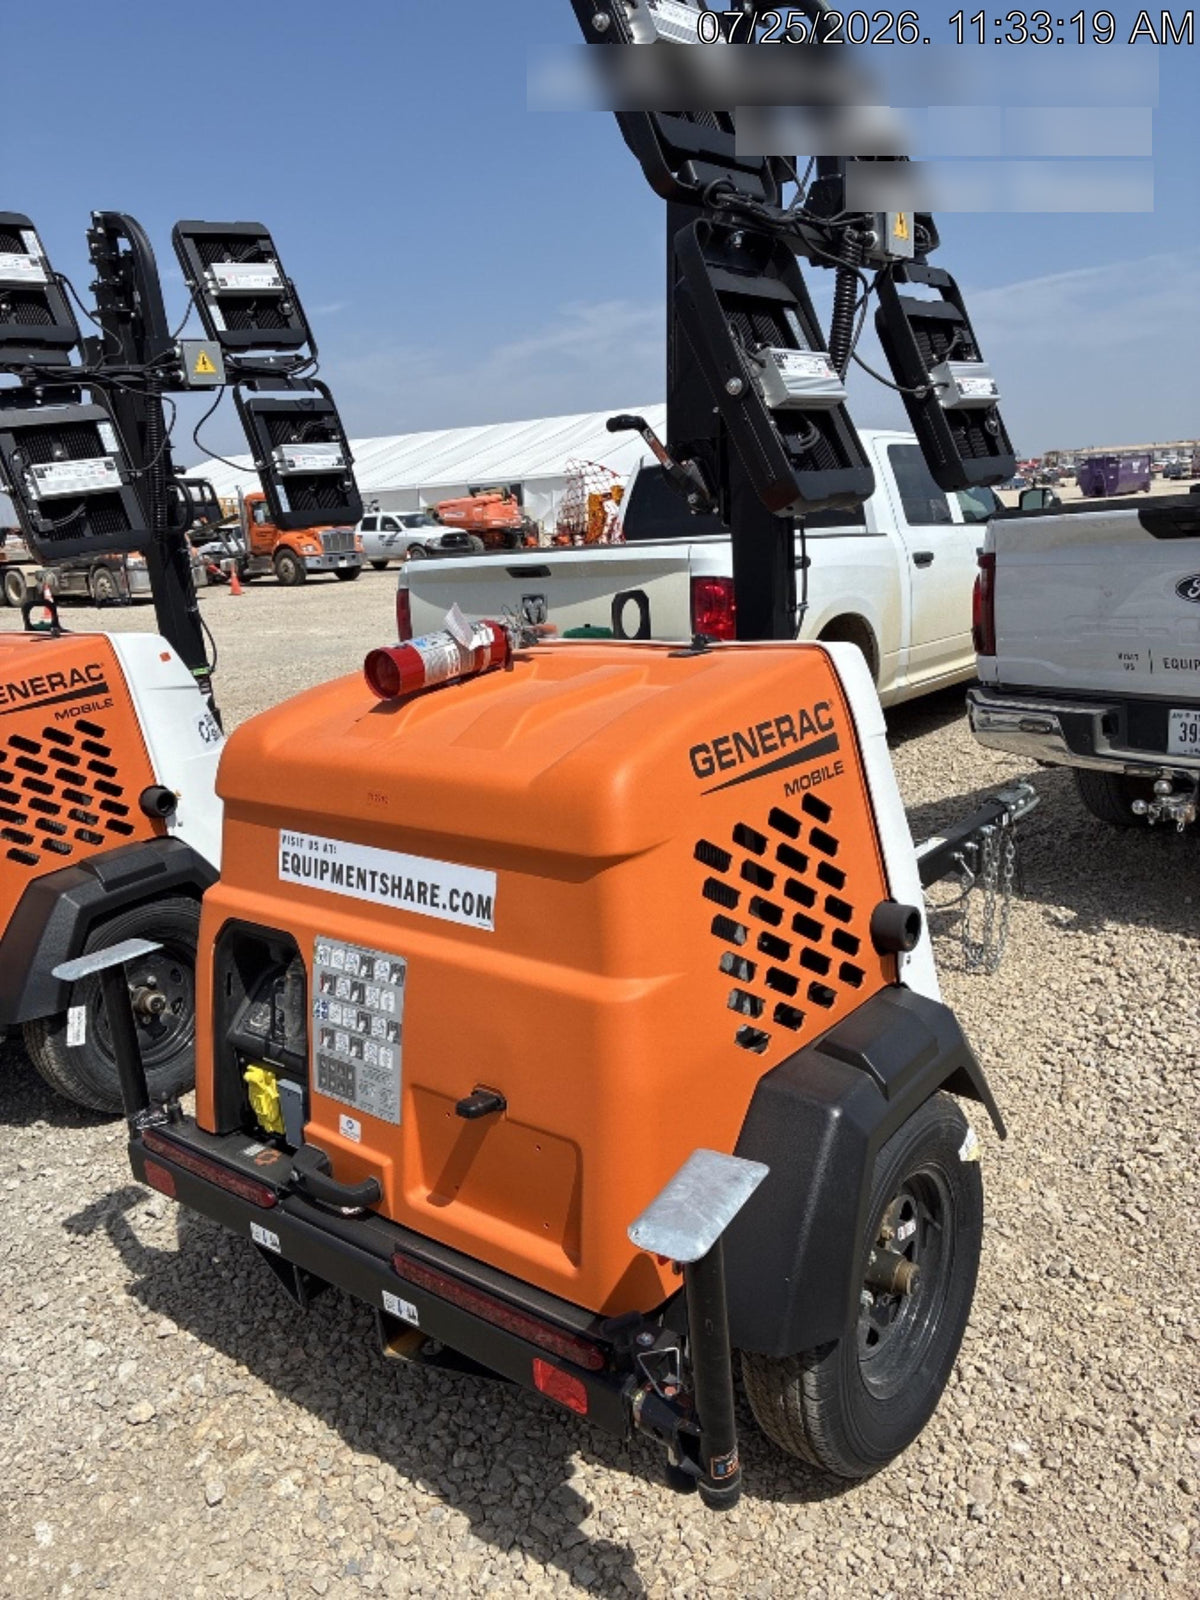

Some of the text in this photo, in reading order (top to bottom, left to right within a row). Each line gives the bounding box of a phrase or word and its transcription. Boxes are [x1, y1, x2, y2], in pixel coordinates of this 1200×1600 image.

[54, 698, 114, 720] MOBILE
[689, 701, 835, 779] GENERAC
[784, 760, 845, 798] MOBILE
[282, 834, 337, 854] VISIT US AT:
[282, 851, 493, 920] EQUIPMENTSHARE.COM
